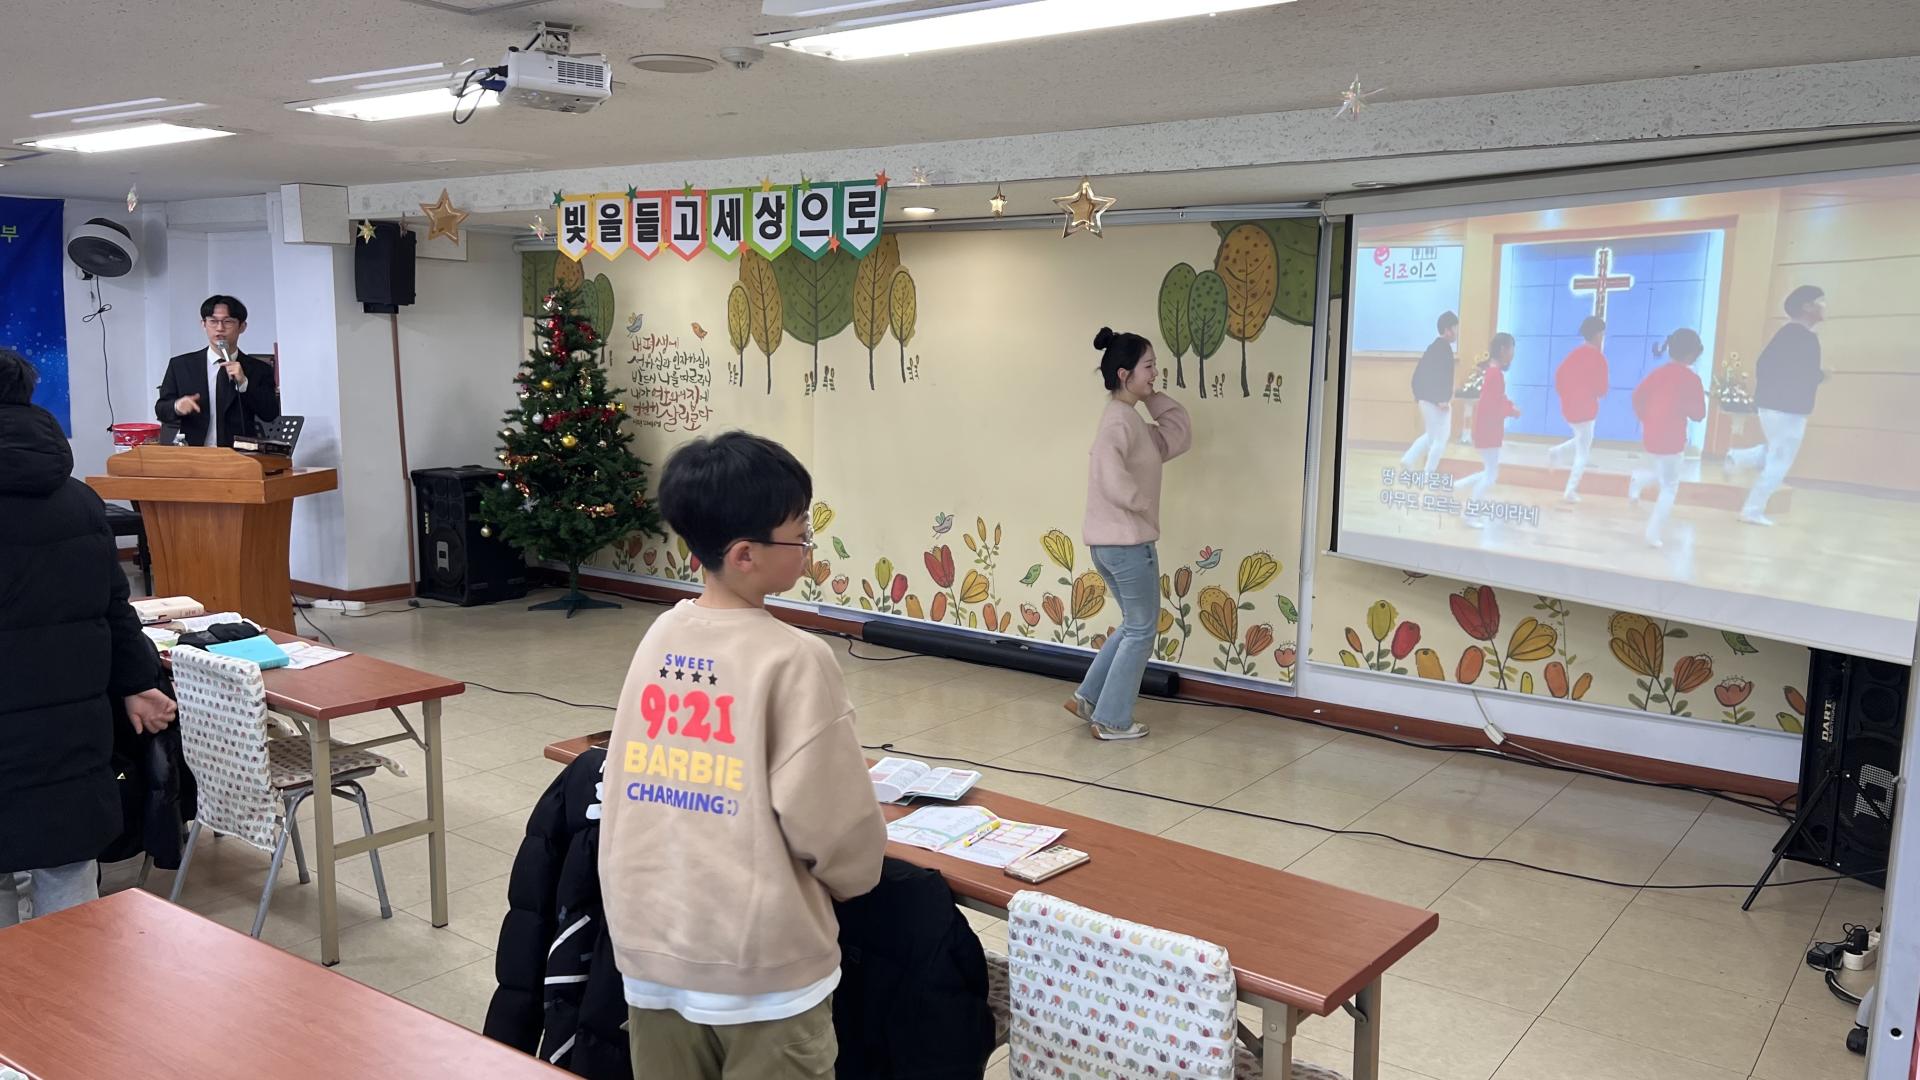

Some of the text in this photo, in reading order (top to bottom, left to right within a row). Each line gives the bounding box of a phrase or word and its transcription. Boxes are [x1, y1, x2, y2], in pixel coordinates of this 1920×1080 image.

[1384, 261, 1437, 280] 리조이스
[1382, 468, 1394, 485] 땅
[1400, 470, 1425, 488] 속에
[1381, 490, 1539, 526] 아무도 모르는 보석이라네
[665, 653, 714, 671] SWEET
[640, 683, 736, 744] 9:21
[1821, 700, 1832, 741] DART
[624, 740, 744, 791] BARBIE
